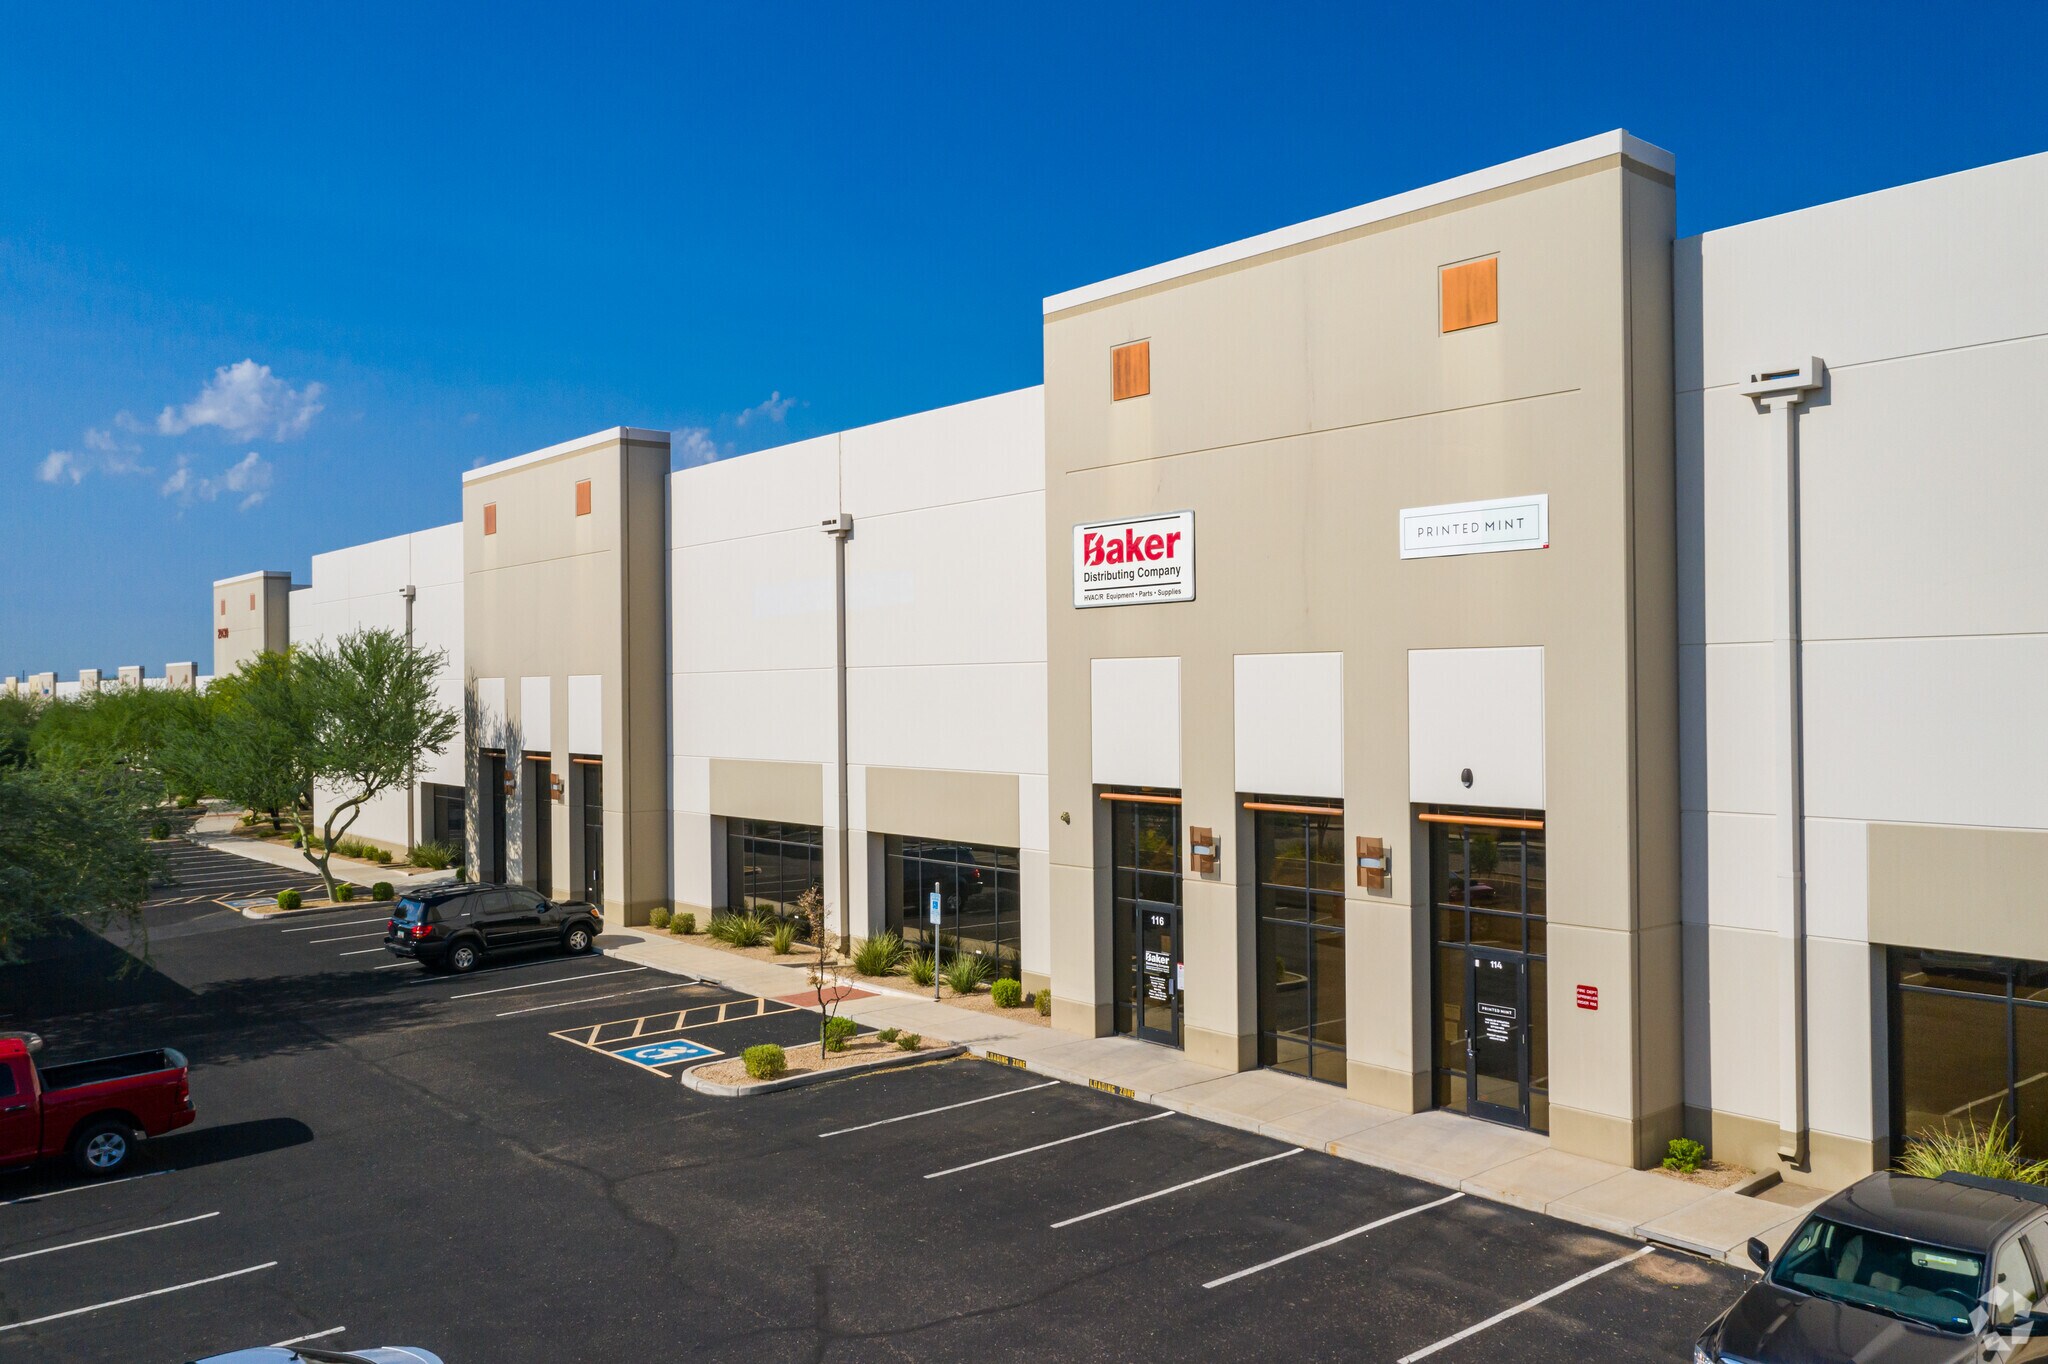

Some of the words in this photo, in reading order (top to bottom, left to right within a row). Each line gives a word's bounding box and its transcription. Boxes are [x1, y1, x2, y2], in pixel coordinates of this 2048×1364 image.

[1417, 522, 1480, 538] PRINTED
[1485, 517, 1524, 532] MINT
[1083, 528, 1181, 567] Baker
[1083, 568, 1135, 583] Distributing
[1137, 566, 1181, 578] Company
[1106, 591, 1135, 600] Equipment
[1157, 588, 1182, 597] Supplies
[1151, 915, 1165, 926] 116
[1145, 952, 1170, 965] Baker
[1490, 960, 1503, 969] 114
[1481, 1005, 1500, 1013] PRINTED
[986, 1051, 1009, 1065] LOADING
[1012, 1058, 1026, 1068] ZONE
[1089, 1079, 1115, 1094] LOADING
[1119, 1087, 1135, 1099] ZONE
